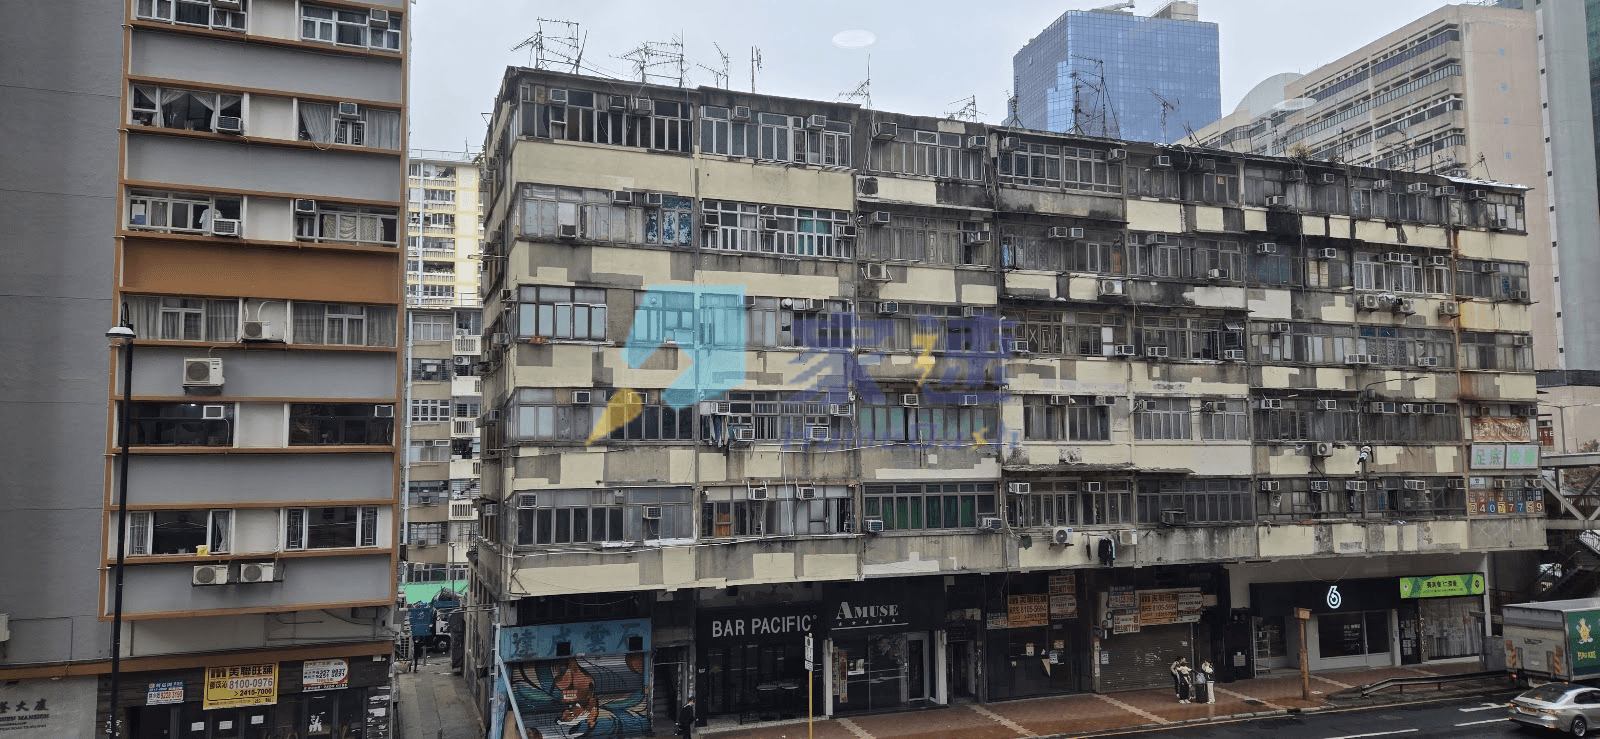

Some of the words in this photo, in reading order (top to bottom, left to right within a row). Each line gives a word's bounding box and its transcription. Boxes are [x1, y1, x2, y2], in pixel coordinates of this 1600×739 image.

[836, 601, 899, 620] AMUSE
[712, 619, 745, 638] BAR
[751, 614, 812, 635] PACIFIC
[229, 664, 273, 677] 美聯旺舖
[229, 677, 273, 690] 8100-0976
